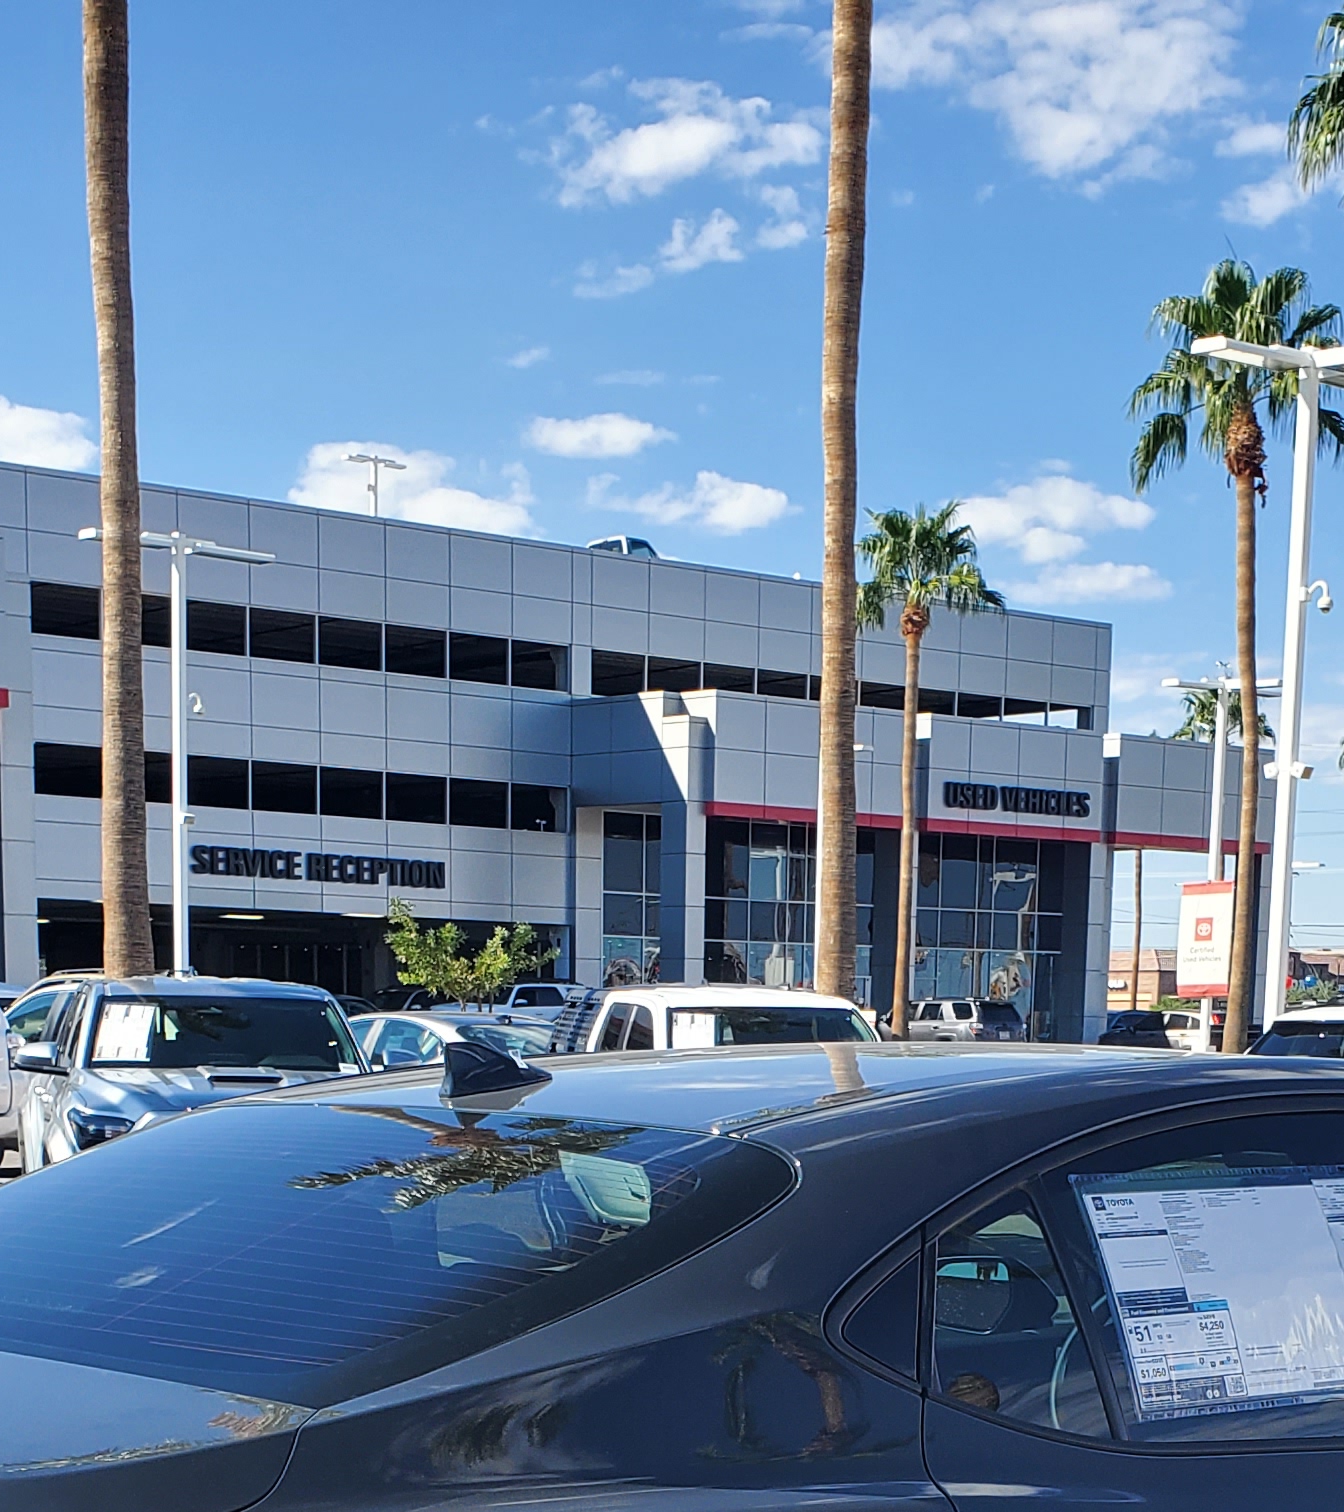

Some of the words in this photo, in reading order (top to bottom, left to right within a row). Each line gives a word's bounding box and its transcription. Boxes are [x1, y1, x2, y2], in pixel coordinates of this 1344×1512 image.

[944, 782, 998, 810] USED
[1000, 786, 1090, 817] VEHICLES
[190, 844, 304, 880] SERVICE
[307, 852, 445, 889] RECEPTION
[1106, 1199, 1135, 1207] TOYOTA
[1134, 1325, 1152, 1342] 51
